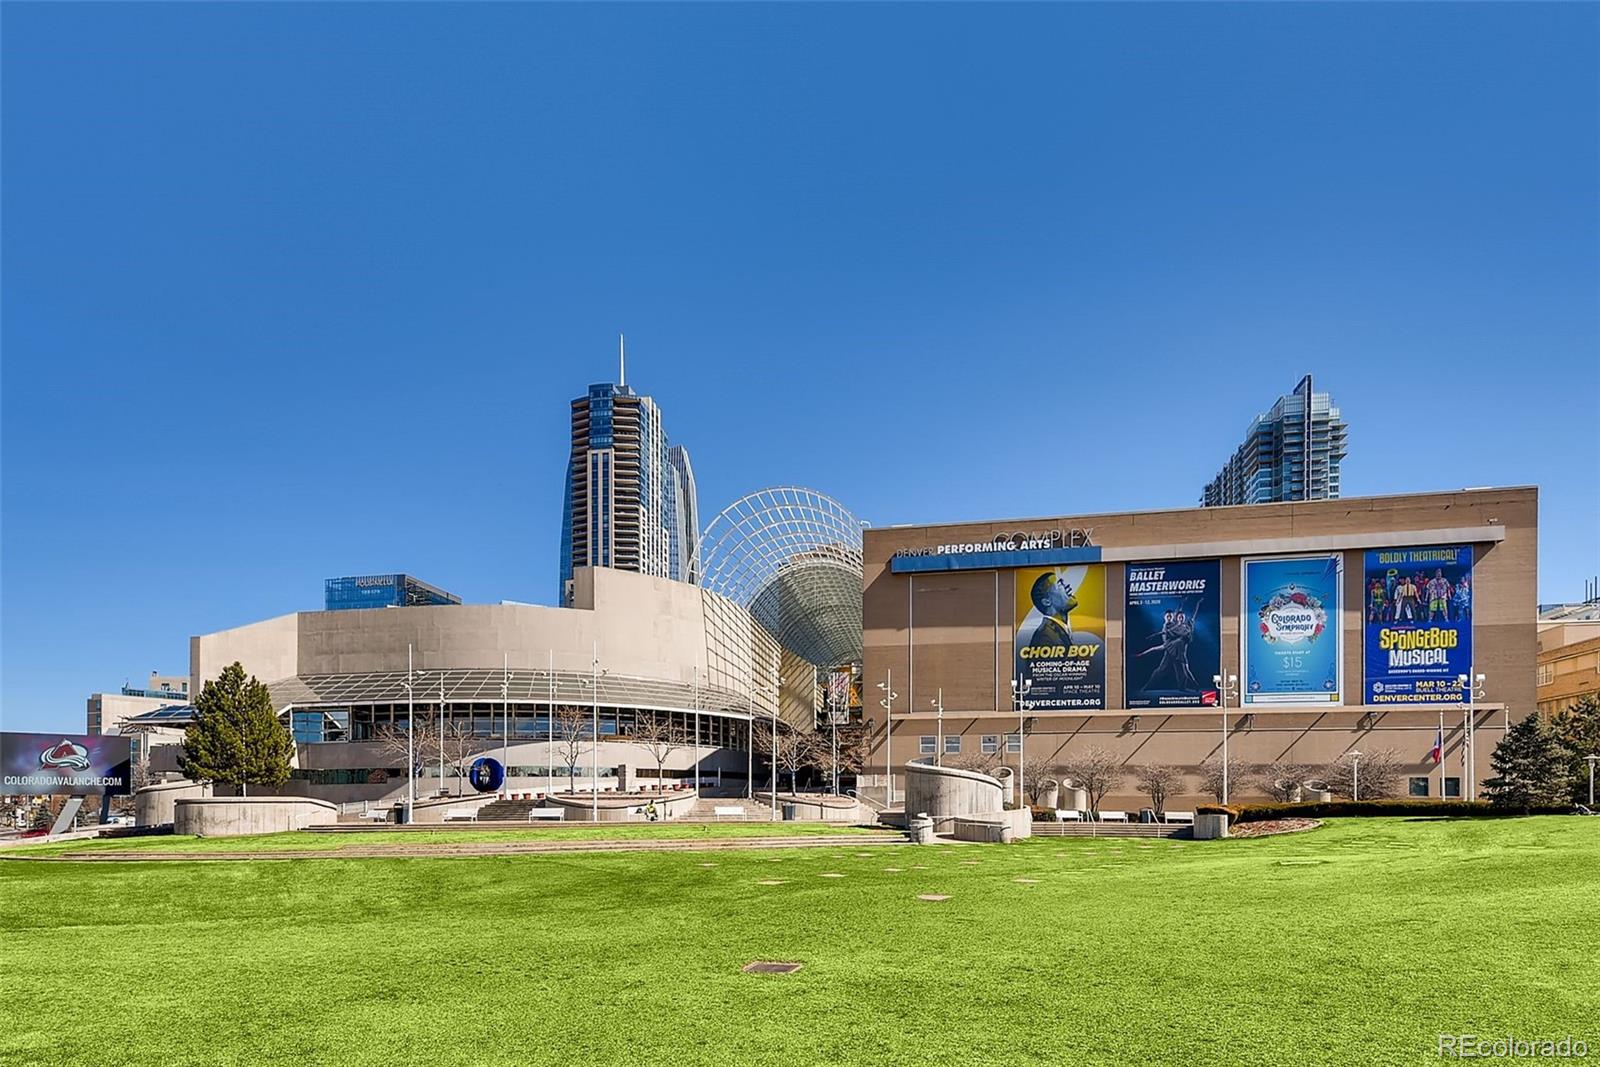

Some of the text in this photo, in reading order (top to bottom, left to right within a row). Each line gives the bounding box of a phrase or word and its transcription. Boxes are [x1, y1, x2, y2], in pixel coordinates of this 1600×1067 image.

[994, 528, 1094, 550] COMPLEX
[896, 538, 1050, 558] DENVER PERFORMING ARTS
[1130, 570, 1166, 581] BALLET
[1129, 580, 1206, 592] MASTERWORKS
[1271, 614, 1312, 624] COLORADO
[1276, 622, 1314, 632] SYMPHONY
[1380, 628, 1458, 650] SPONGEBOB
[1020, 644, 1100, 659] CHOIR BOY
[1388, 648, 1450, 667] MUSICAL
[1282, 656, 1302, 668] $15
[1373, 694, 1462, 702] DENVERCENTER.ORG
[4, 776, 122, 786] COLORADOAVALANCHE.COM
